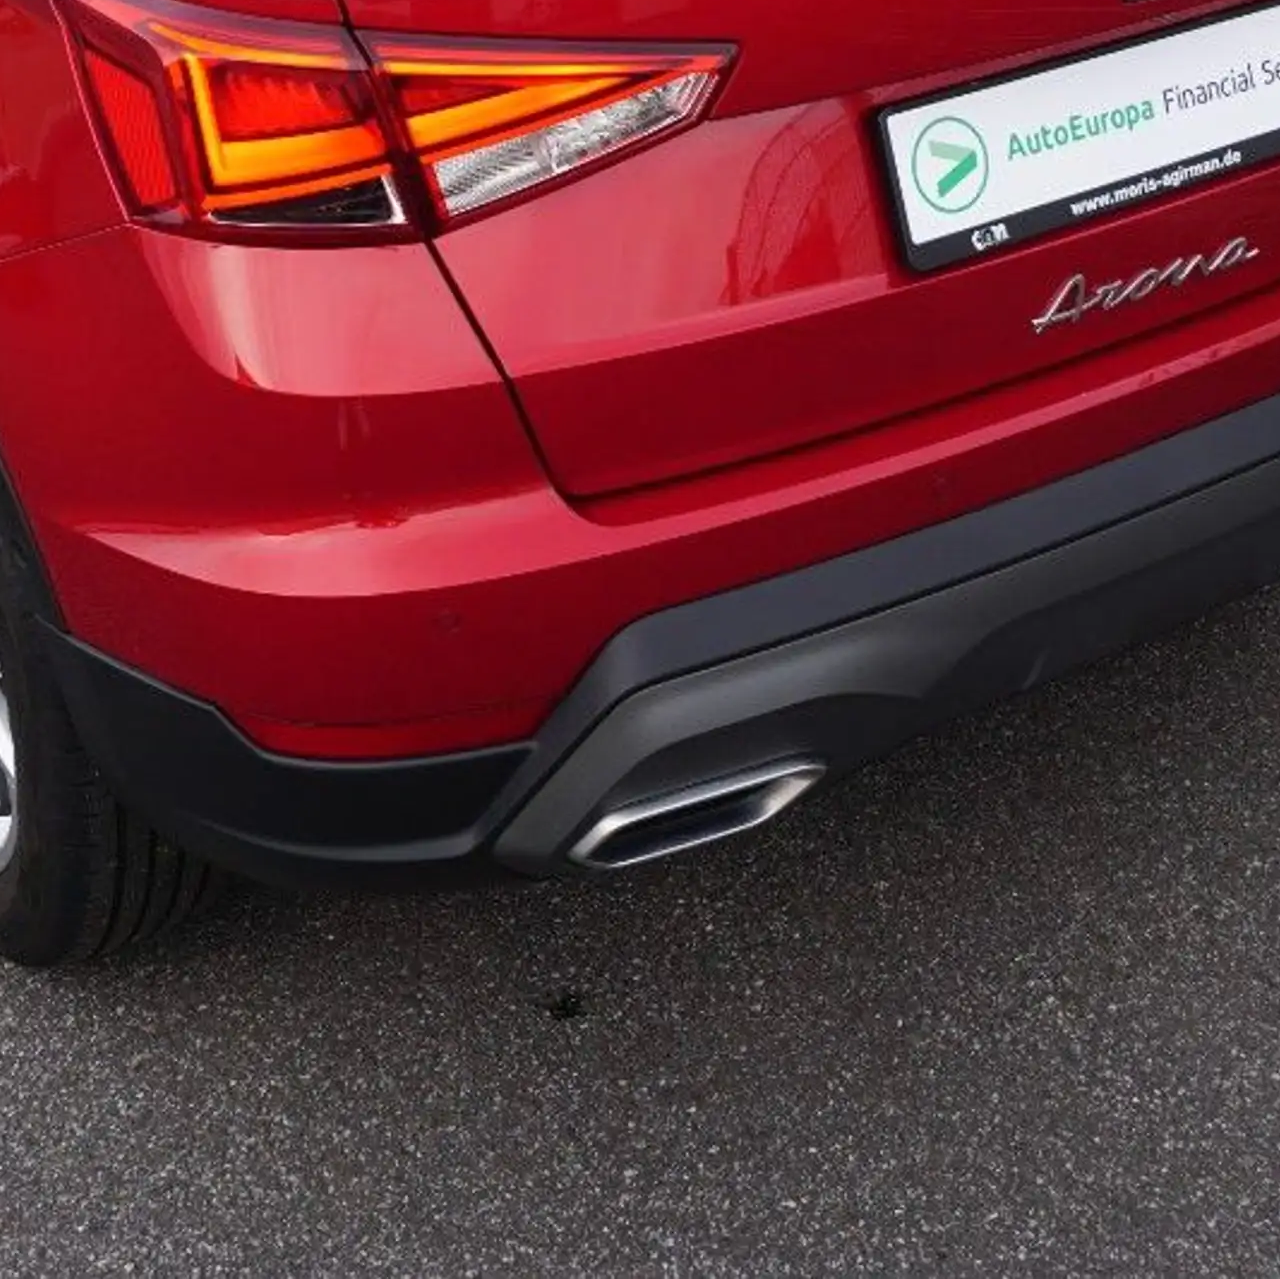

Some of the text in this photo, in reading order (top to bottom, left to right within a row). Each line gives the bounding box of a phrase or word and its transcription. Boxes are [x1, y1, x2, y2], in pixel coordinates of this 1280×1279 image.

[1007, 98, 1156, 161] AutoEuropa
[1162, 63, 1257, 115] Financial
[1070, 148, 1243, 216] www.moris-agirman.de
[1031, 235, 1261, 335] Arona
